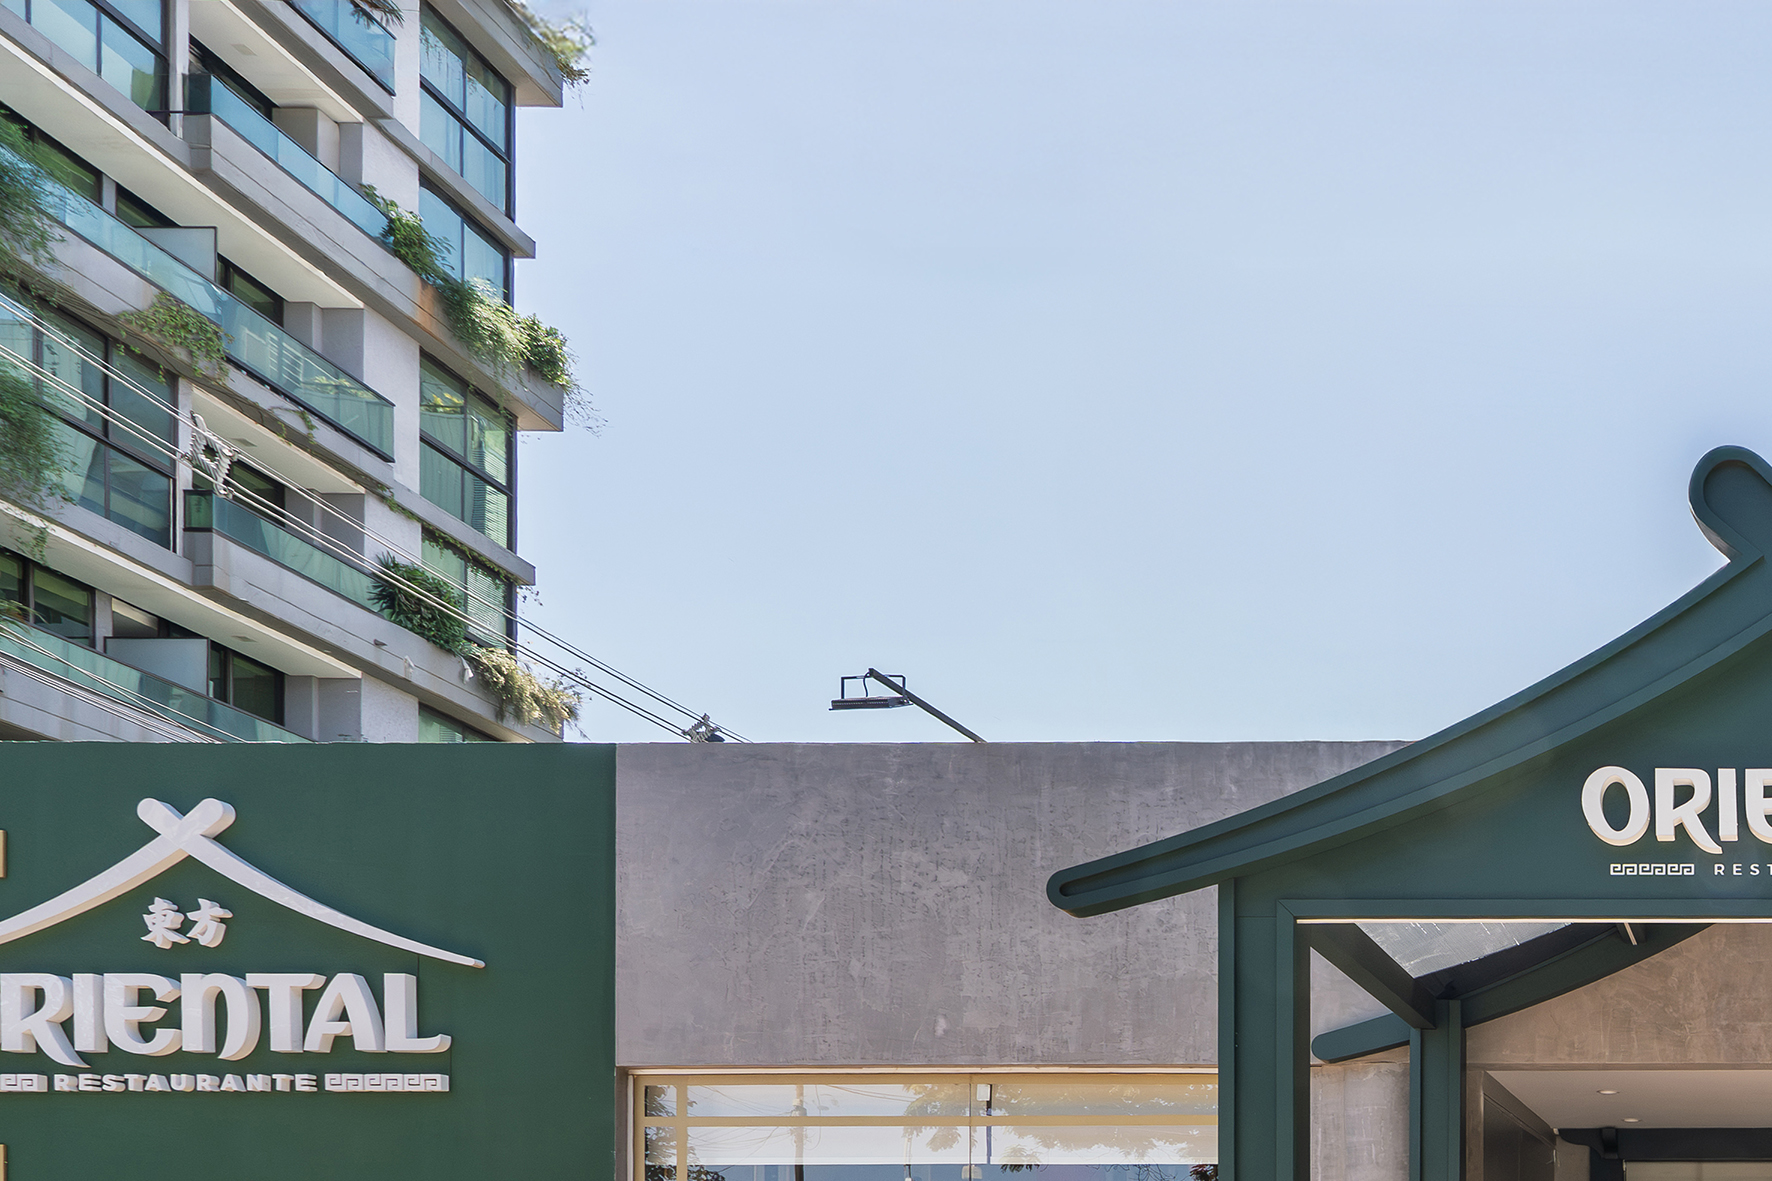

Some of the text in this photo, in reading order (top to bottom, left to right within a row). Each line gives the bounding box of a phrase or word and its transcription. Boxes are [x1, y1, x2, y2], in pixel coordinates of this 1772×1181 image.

[140, 897, 233, 949] 東方
[0, 972, 451, 1068] RIENTAL
[54, 1073, 318, 1093] RESTAURANTE
